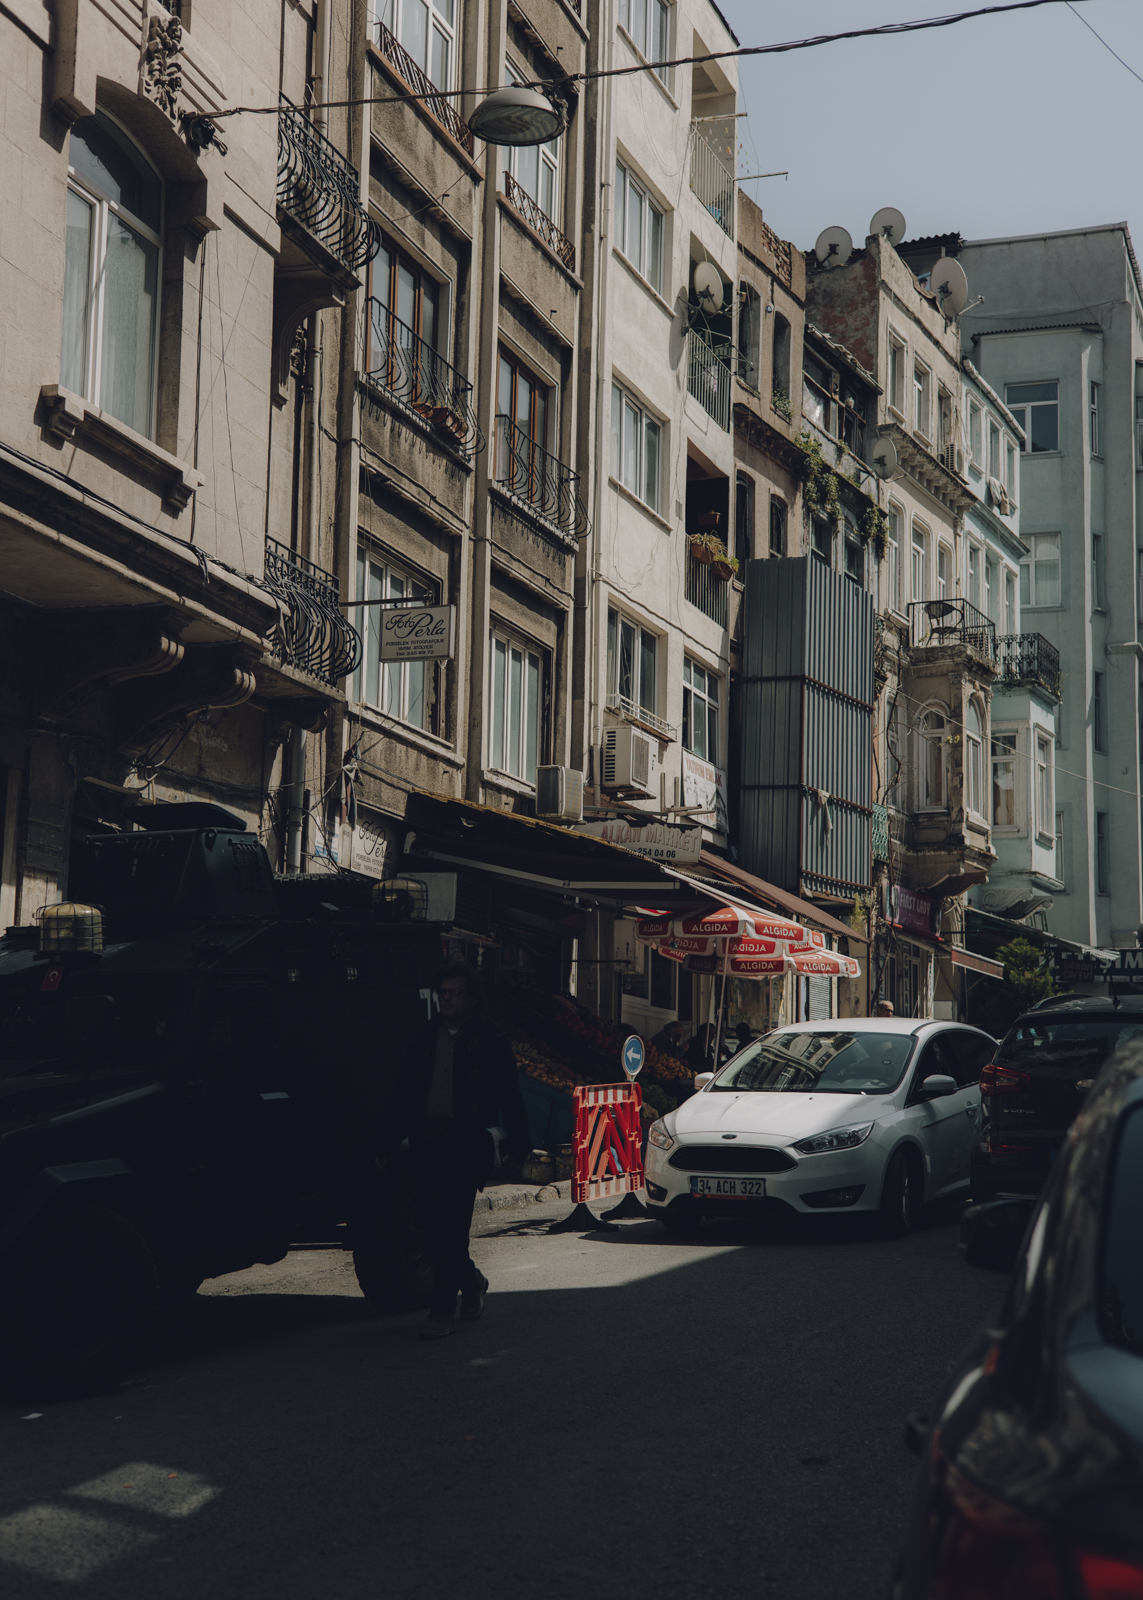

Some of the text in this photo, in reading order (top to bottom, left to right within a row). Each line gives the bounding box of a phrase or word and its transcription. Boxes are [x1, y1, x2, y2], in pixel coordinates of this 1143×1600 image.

[386, 612, 446, 639] Foto Perla
[685, 757, 723, 788] YATIRIM EMLAK
[363, 825, 393, 861] Perla
[645, 825, 698, 853] MARKET
[654, 848, 664, 858] 04
[666, 850, 676, 859] 06
[899, 892, 931, 917] FIRST LADY
[1063, 961, 1094, 972] BARAN
[1063, 969, 1078, 980] ÇAY
[698, 1179, 762, 1196] 34 ACH 322
